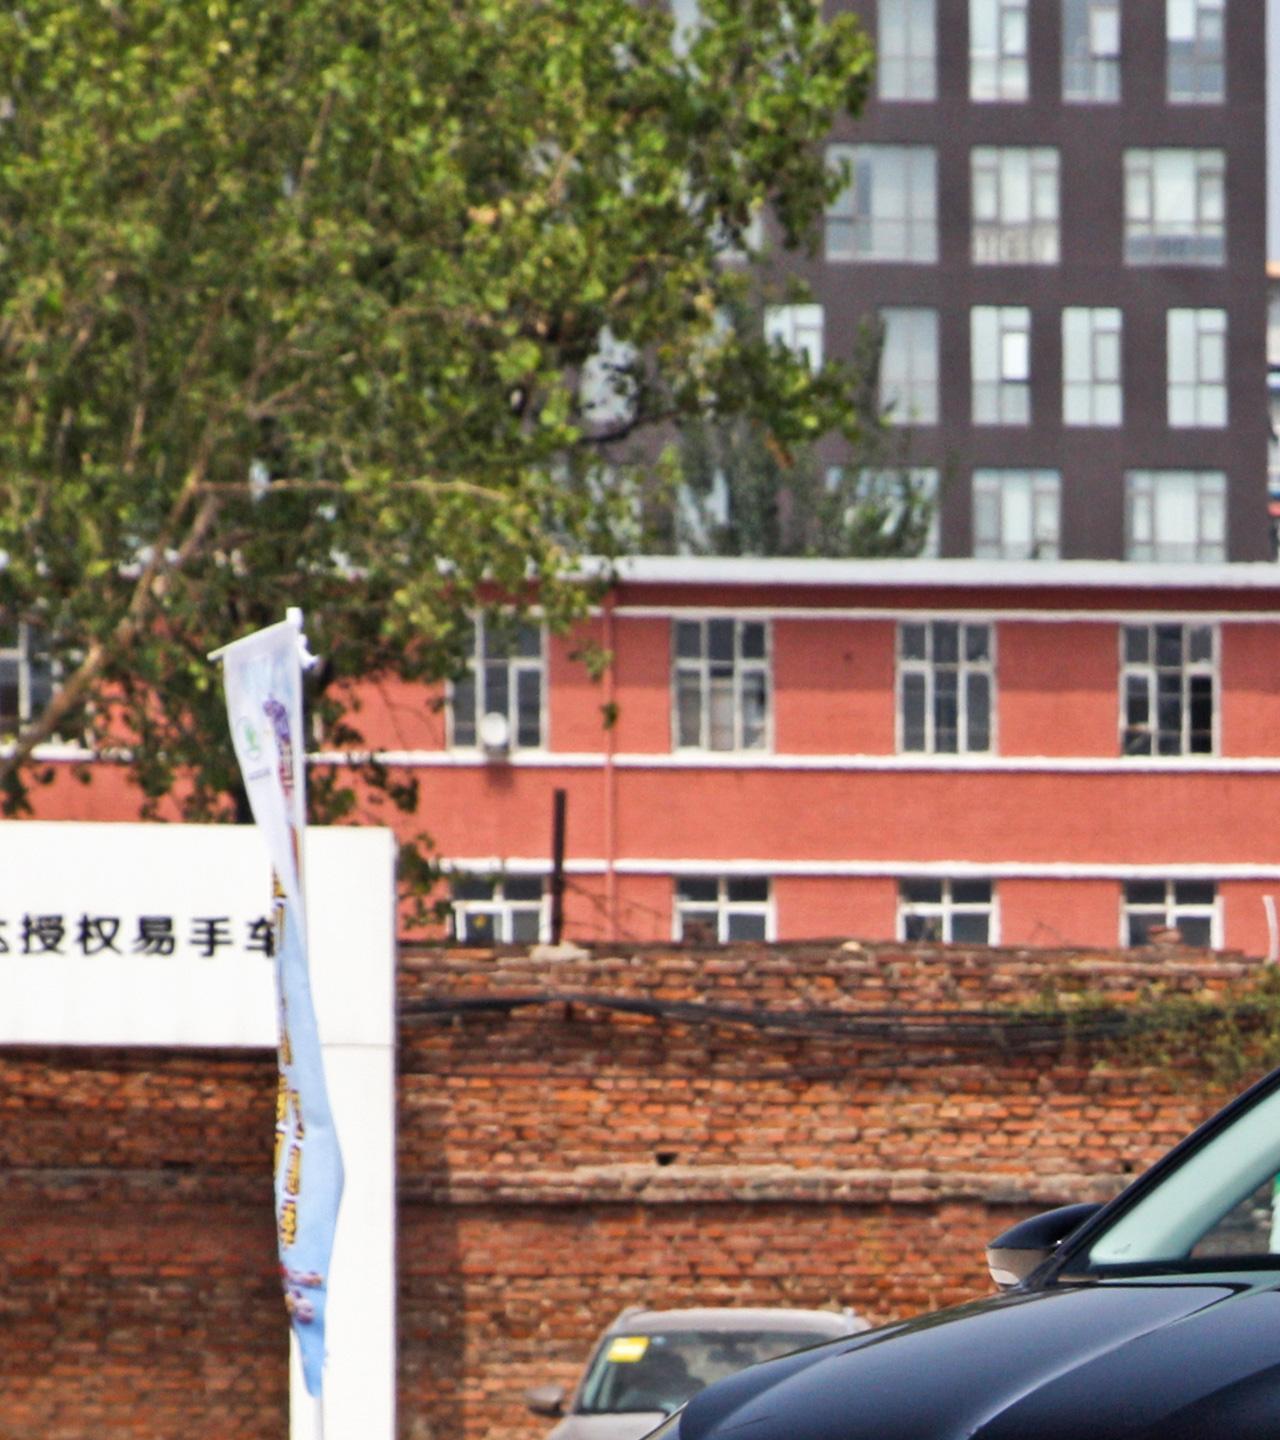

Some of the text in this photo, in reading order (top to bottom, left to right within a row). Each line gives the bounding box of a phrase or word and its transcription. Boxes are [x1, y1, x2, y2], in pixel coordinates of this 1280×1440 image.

[0, 912, 275, 958] 授权易手车
